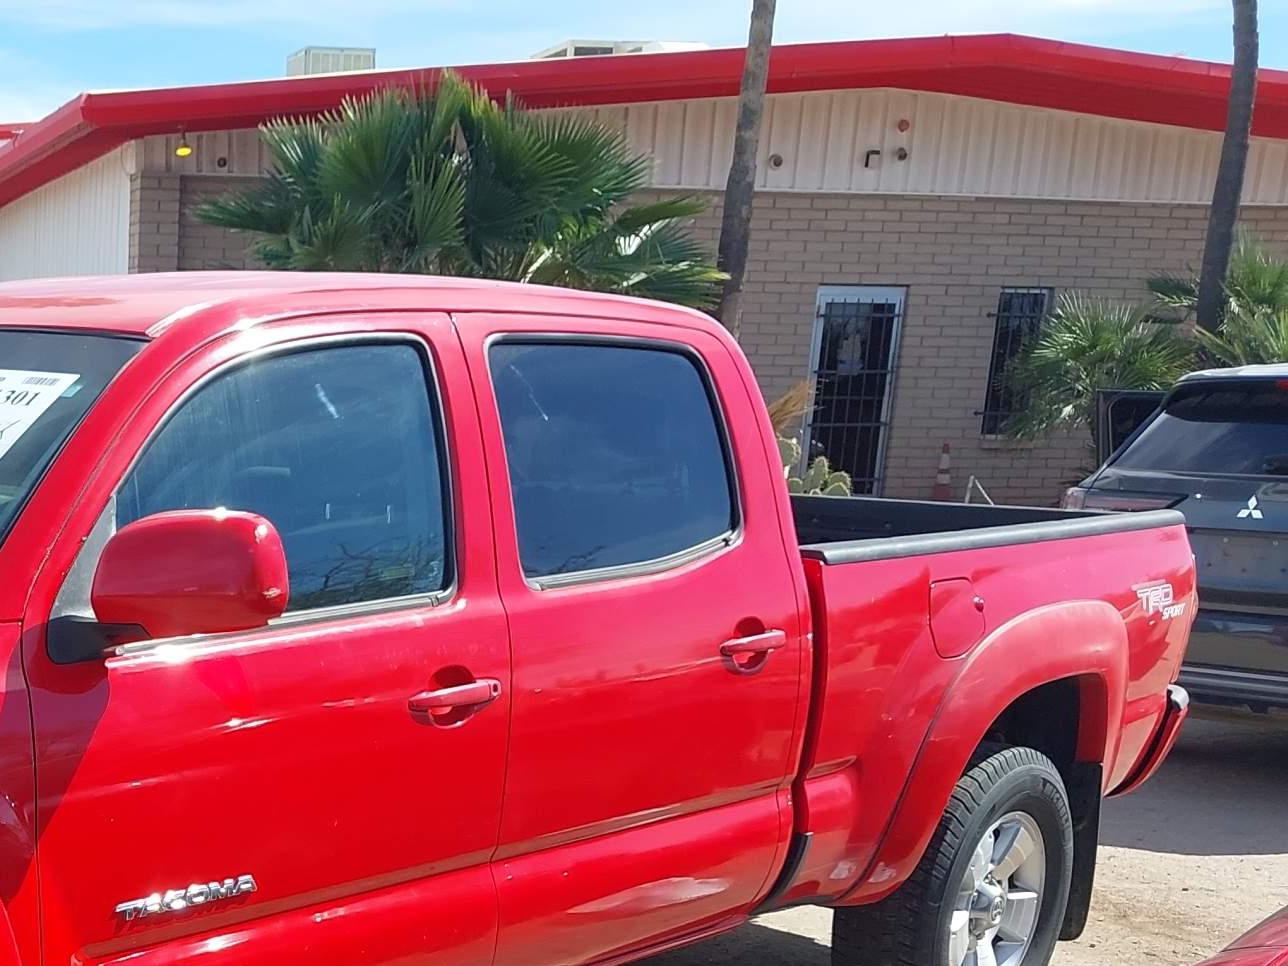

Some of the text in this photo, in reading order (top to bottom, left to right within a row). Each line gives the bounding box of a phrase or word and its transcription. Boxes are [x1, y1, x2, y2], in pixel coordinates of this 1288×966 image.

[1134, 582, 1174, 616] TRD
[1162, 603, 1186, 620] SPORT
[115, 874, 258, 921] TACOMA
